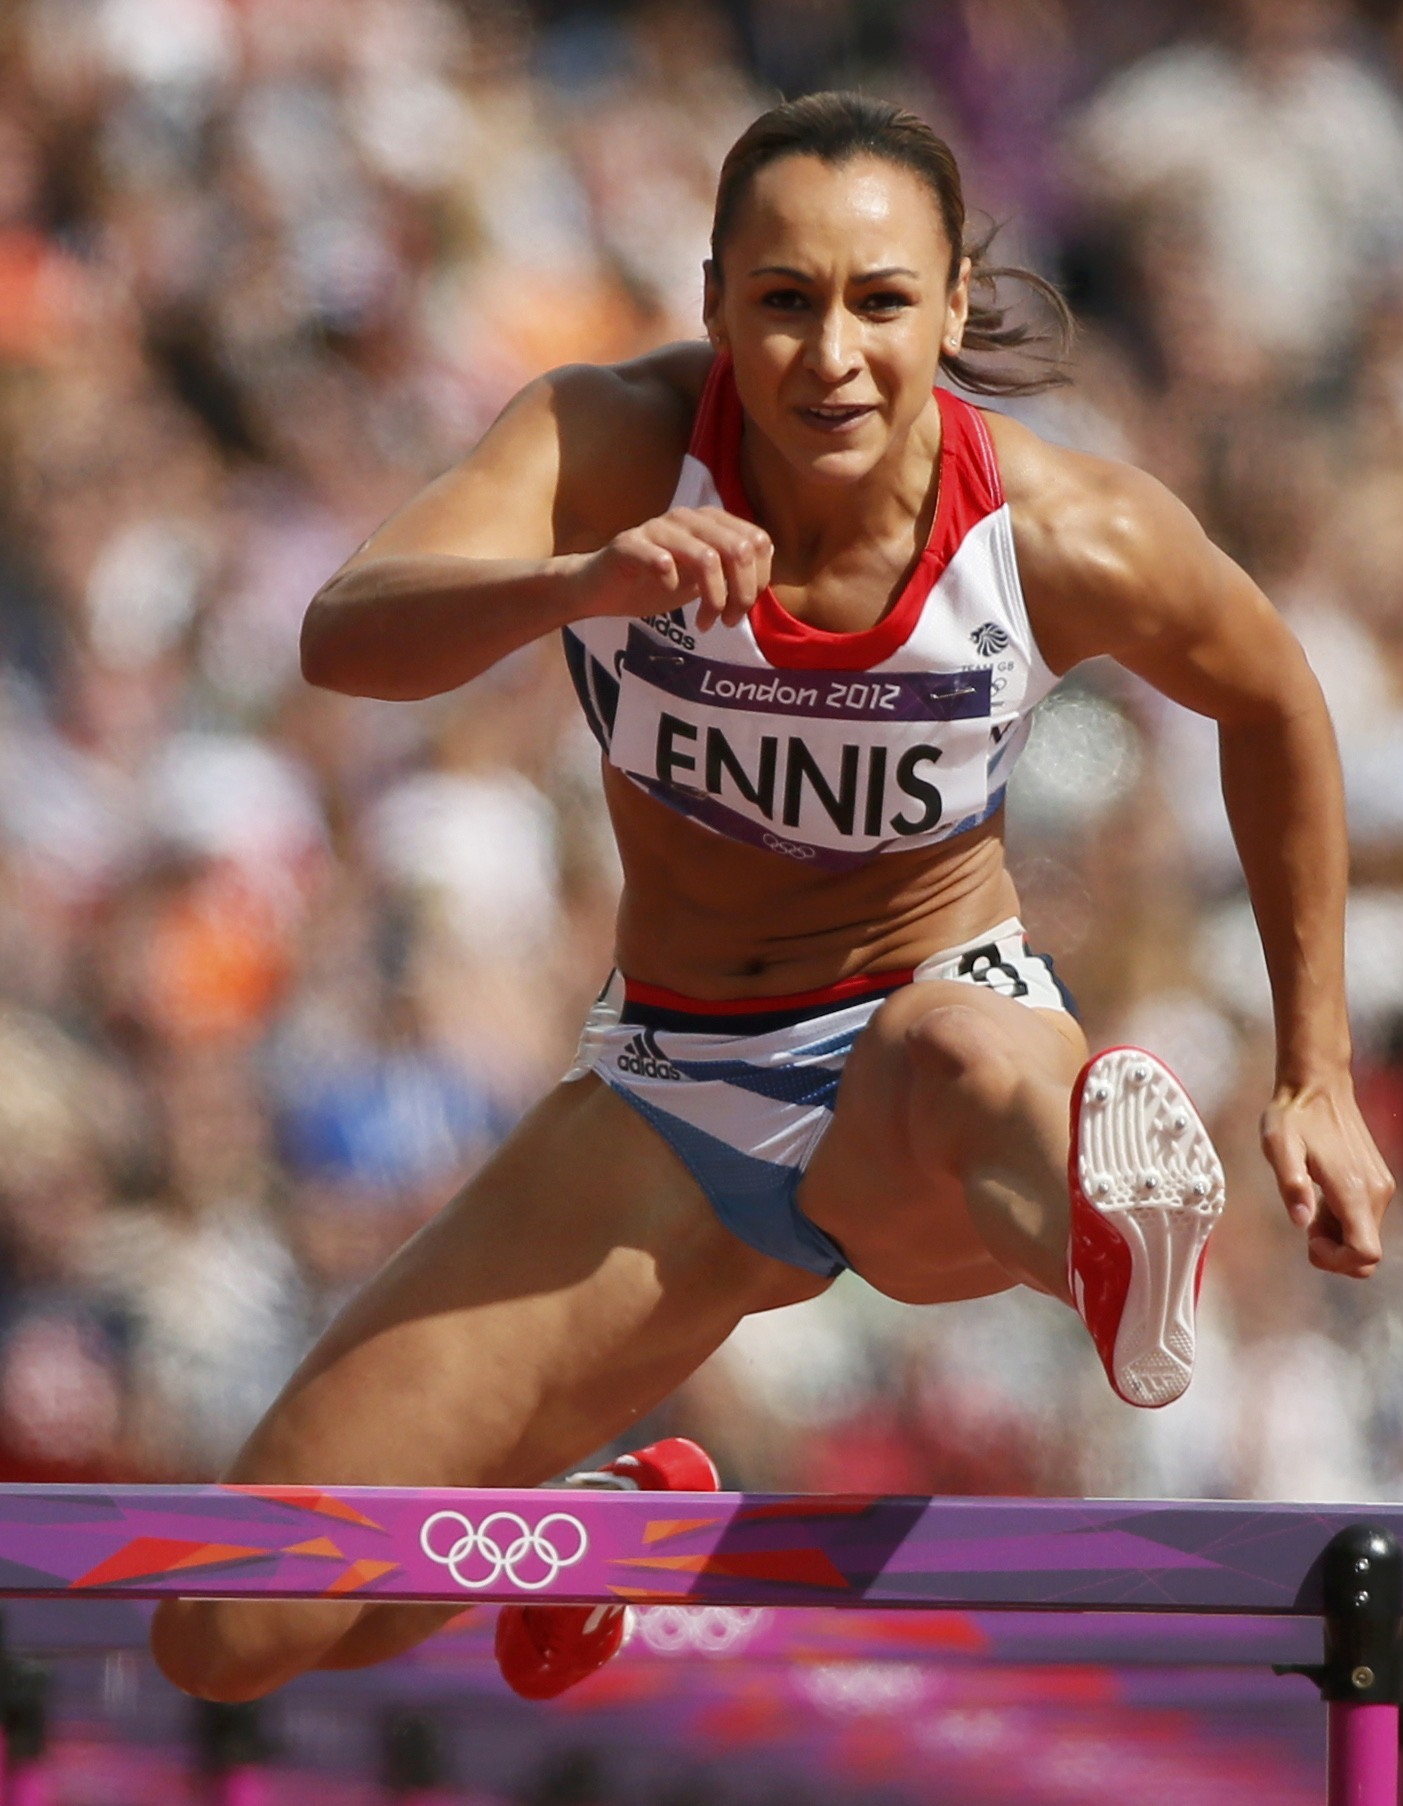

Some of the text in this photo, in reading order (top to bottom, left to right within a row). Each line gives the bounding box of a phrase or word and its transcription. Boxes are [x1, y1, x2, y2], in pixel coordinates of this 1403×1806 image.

[996, 660, 1015, 672] GB
[700, 670, 901, 710] London 2012
[655, 711, 943, 837] ENNIS
[616, 1053, 681, 1081] adidas
